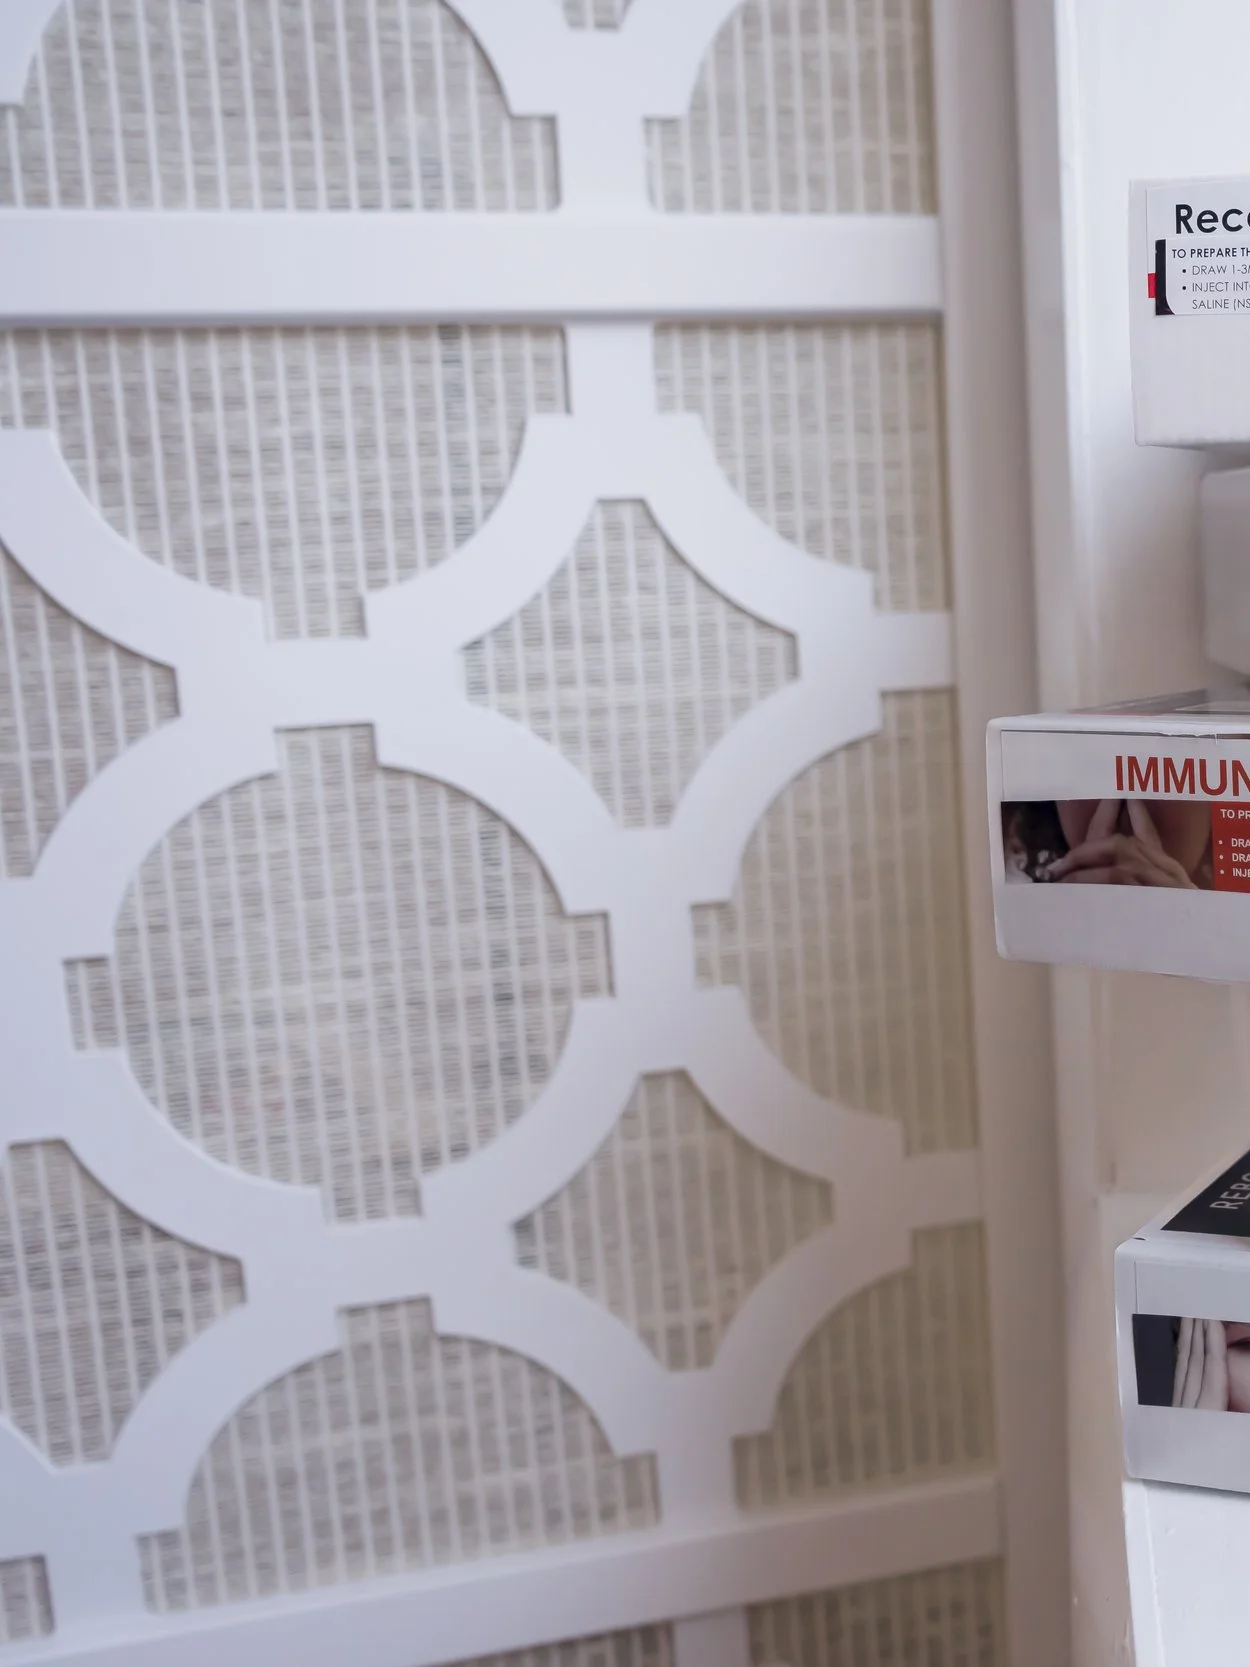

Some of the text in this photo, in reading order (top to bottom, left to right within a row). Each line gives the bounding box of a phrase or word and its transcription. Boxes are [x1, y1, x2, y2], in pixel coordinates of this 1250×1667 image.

[1172, 249, 1186, 258] TO
[1190, 248, 1237, 258] PREPARE
[1192, 265, 1227, 275] DRAW
[1192, 282, 1229, 292] INJECT
[1192, 299, 1229, 309] SALINE
[1220, 809, 1235, 819] TO
